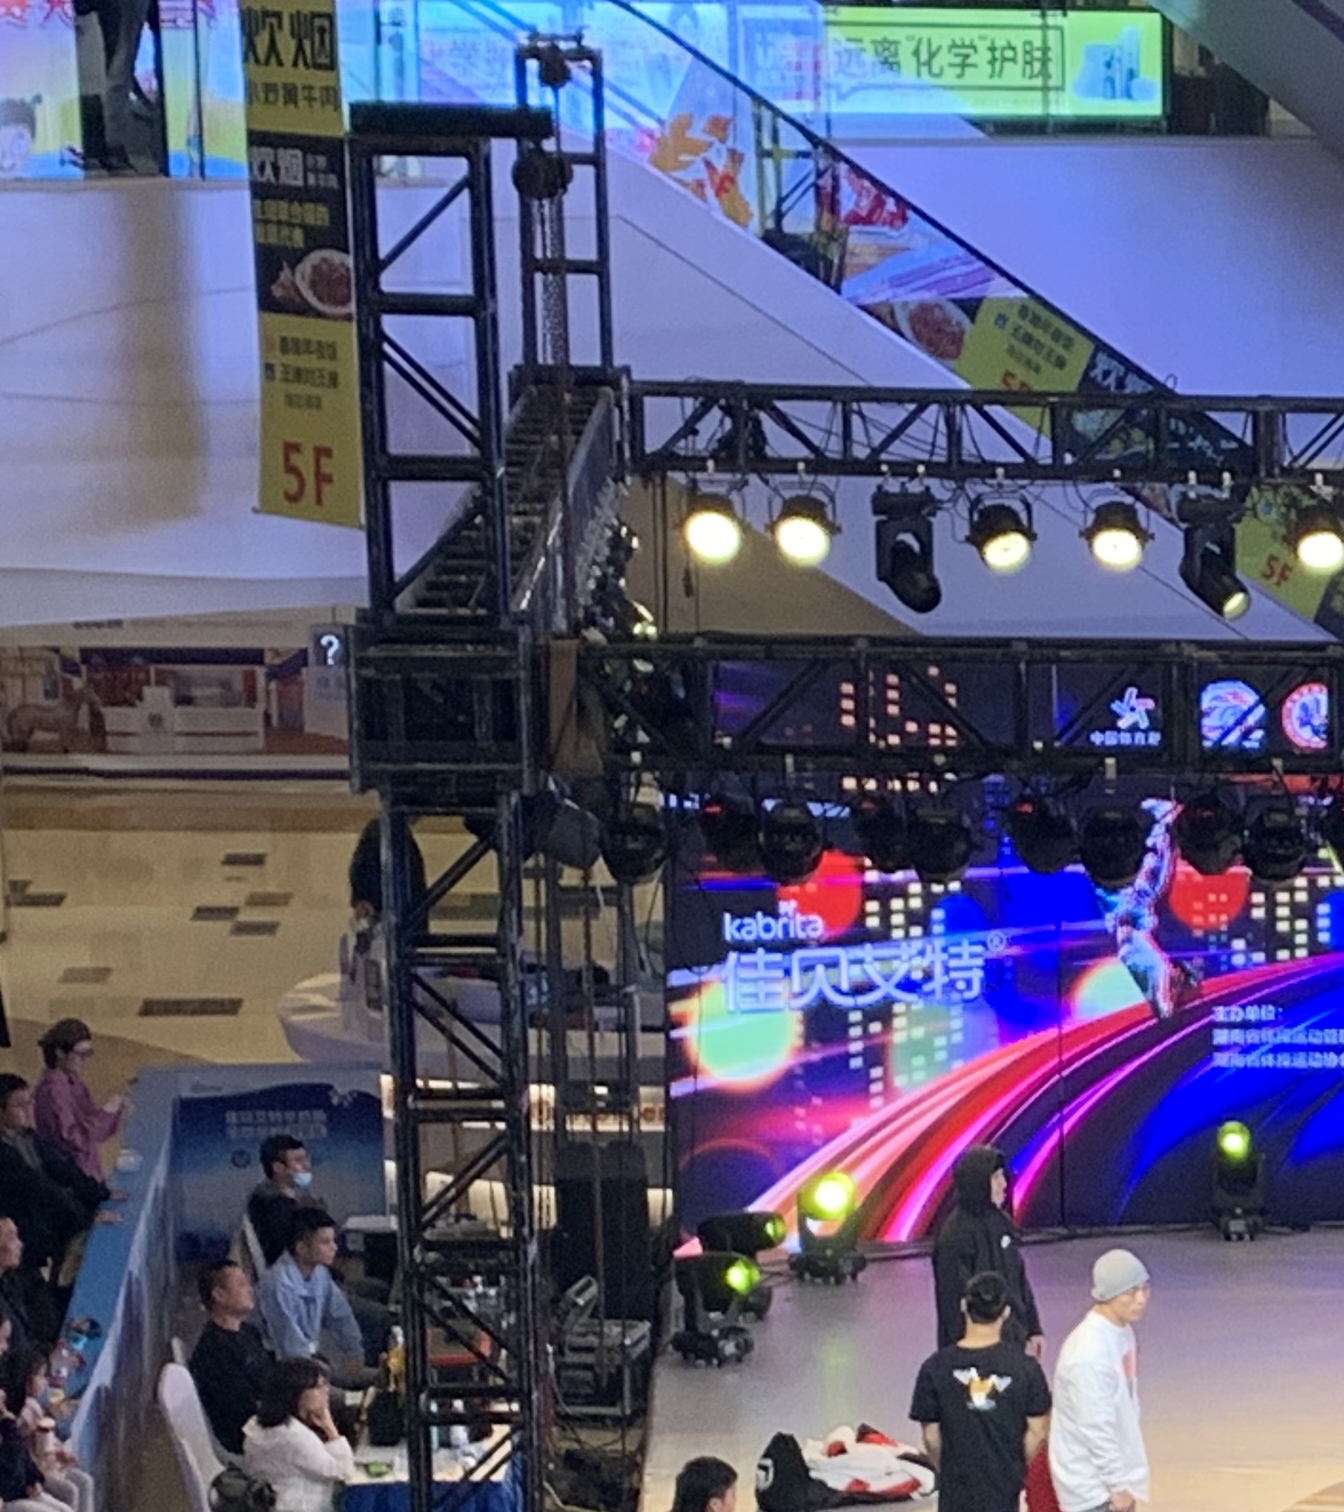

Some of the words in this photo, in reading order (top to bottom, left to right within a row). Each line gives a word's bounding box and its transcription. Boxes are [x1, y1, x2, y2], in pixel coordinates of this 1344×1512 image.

[282, 439, 335, 508] 5F
[1261, 553, 1293, 588] 5F
[722, 911, 825, 942] kabrita
[723, 939, 986, 1013] 佳贝艾特
